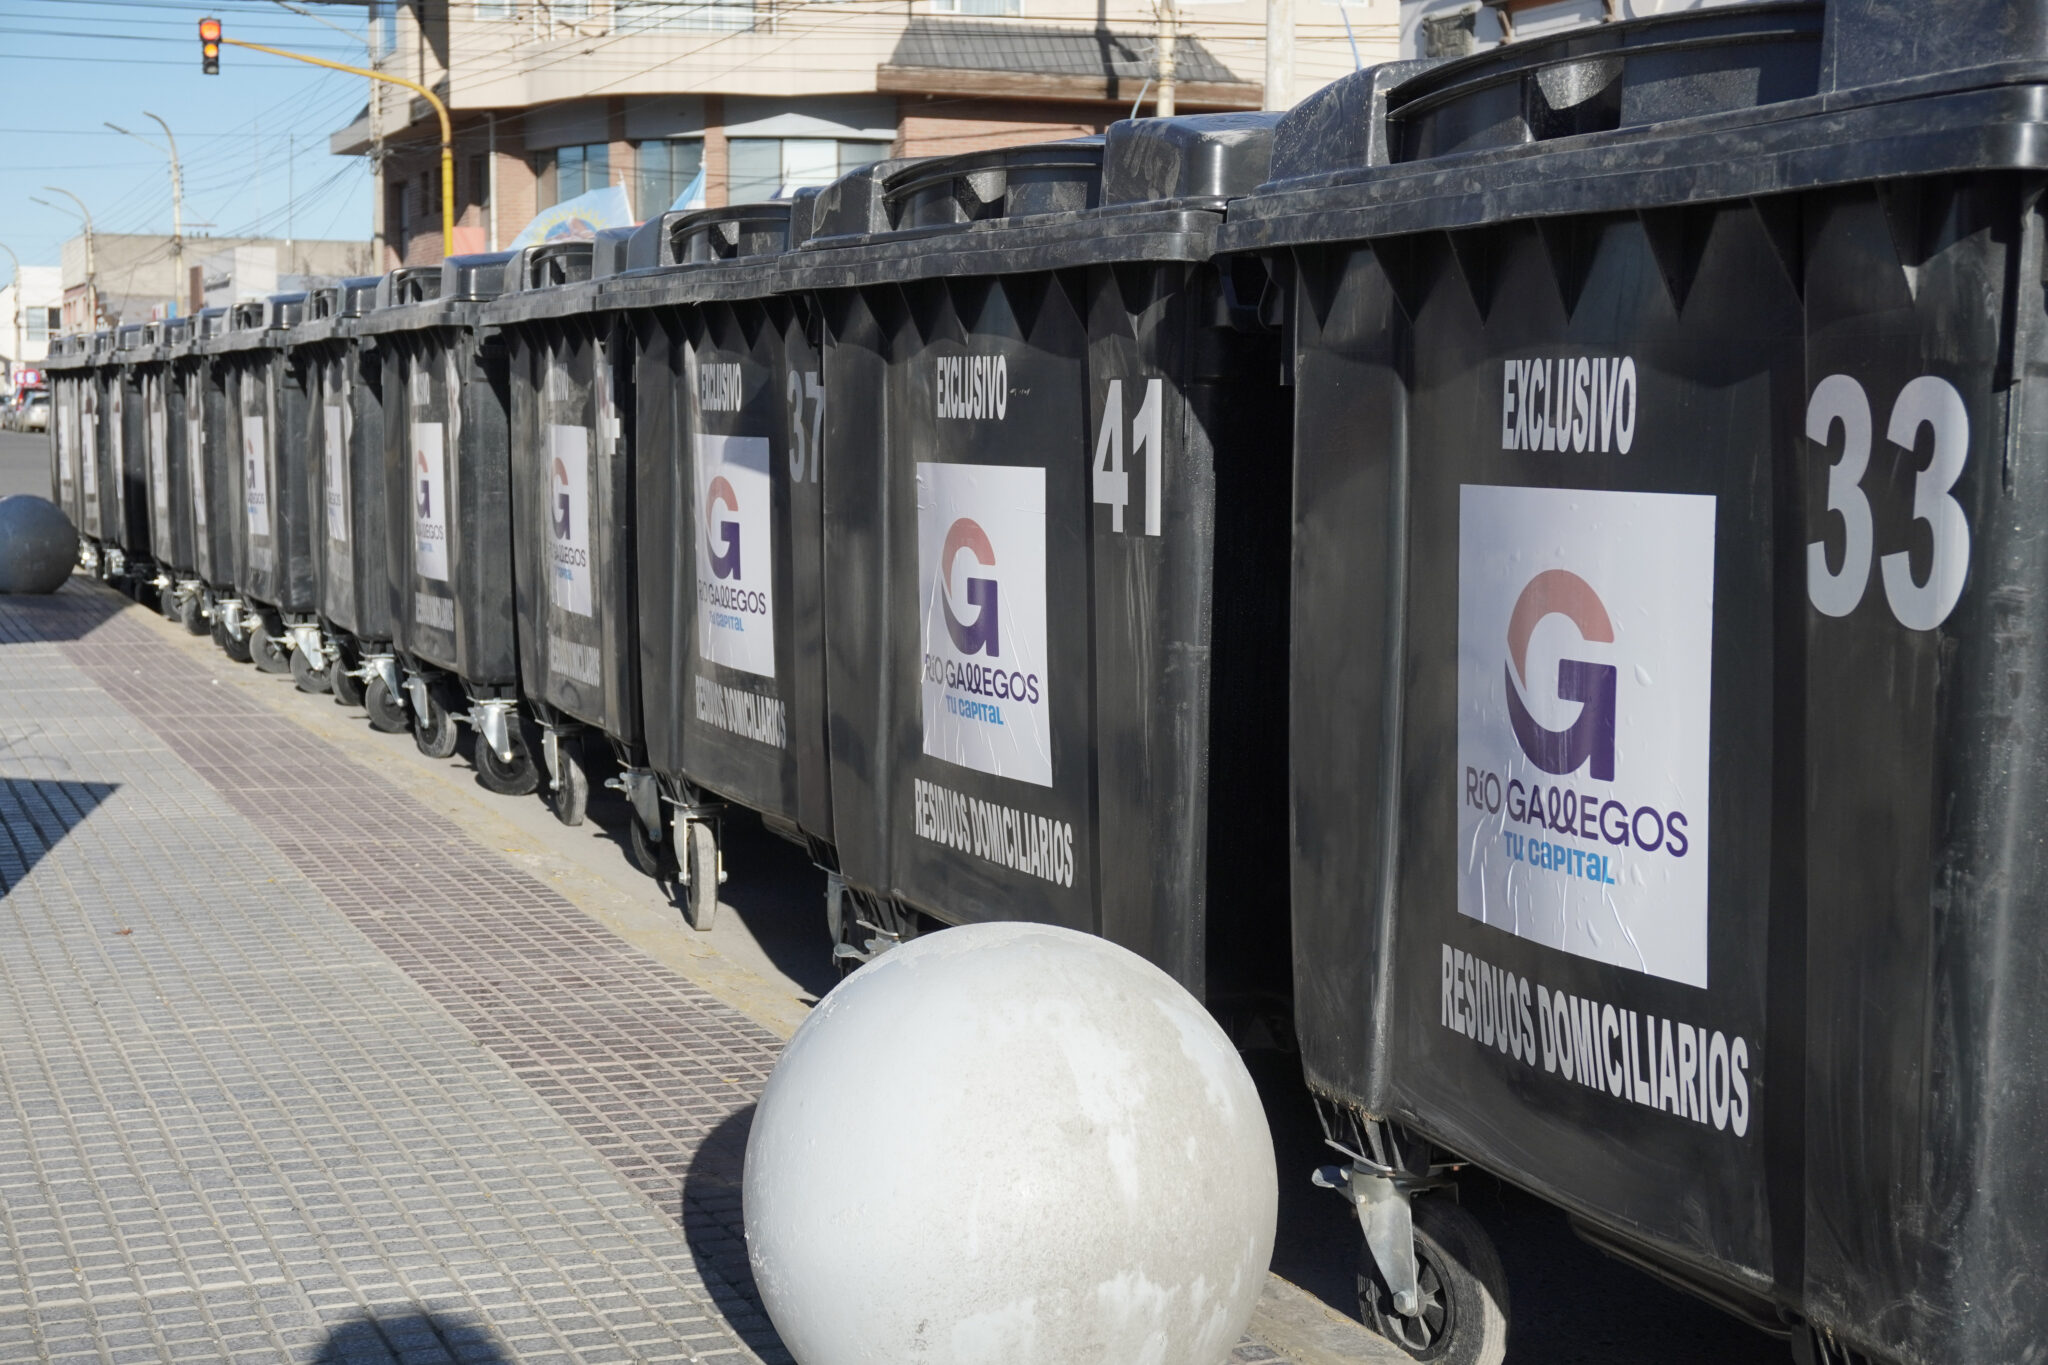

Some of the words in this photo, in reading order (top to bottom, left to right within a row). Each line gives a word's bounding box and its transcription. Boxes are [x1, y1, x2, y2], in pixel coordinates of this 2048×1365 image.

[701, 362, 742, 412] EXCLUSIVO
[787, 369, 825, 484] 37
[937, 354, 1007, 421] EXCLUSIVO
[1502, 355, 1637, 455] EXCLUSIVO
[1092, 378, 1163, 537] 41
[1805, 373, 1971, 632] 33
[705, 475, 742, 581] G
[941, 517, 1001, 658] G
[1504, 568, 1618, 783] G
[914, 777, 971, 855] RESIDUOS
[969, 796, 1074, 889] DOMICILIARIOS
[1441, 943, 1537, 1067] RESIDUOS
[1537, 984, 1750, 1138] DOMICILIARIOS
